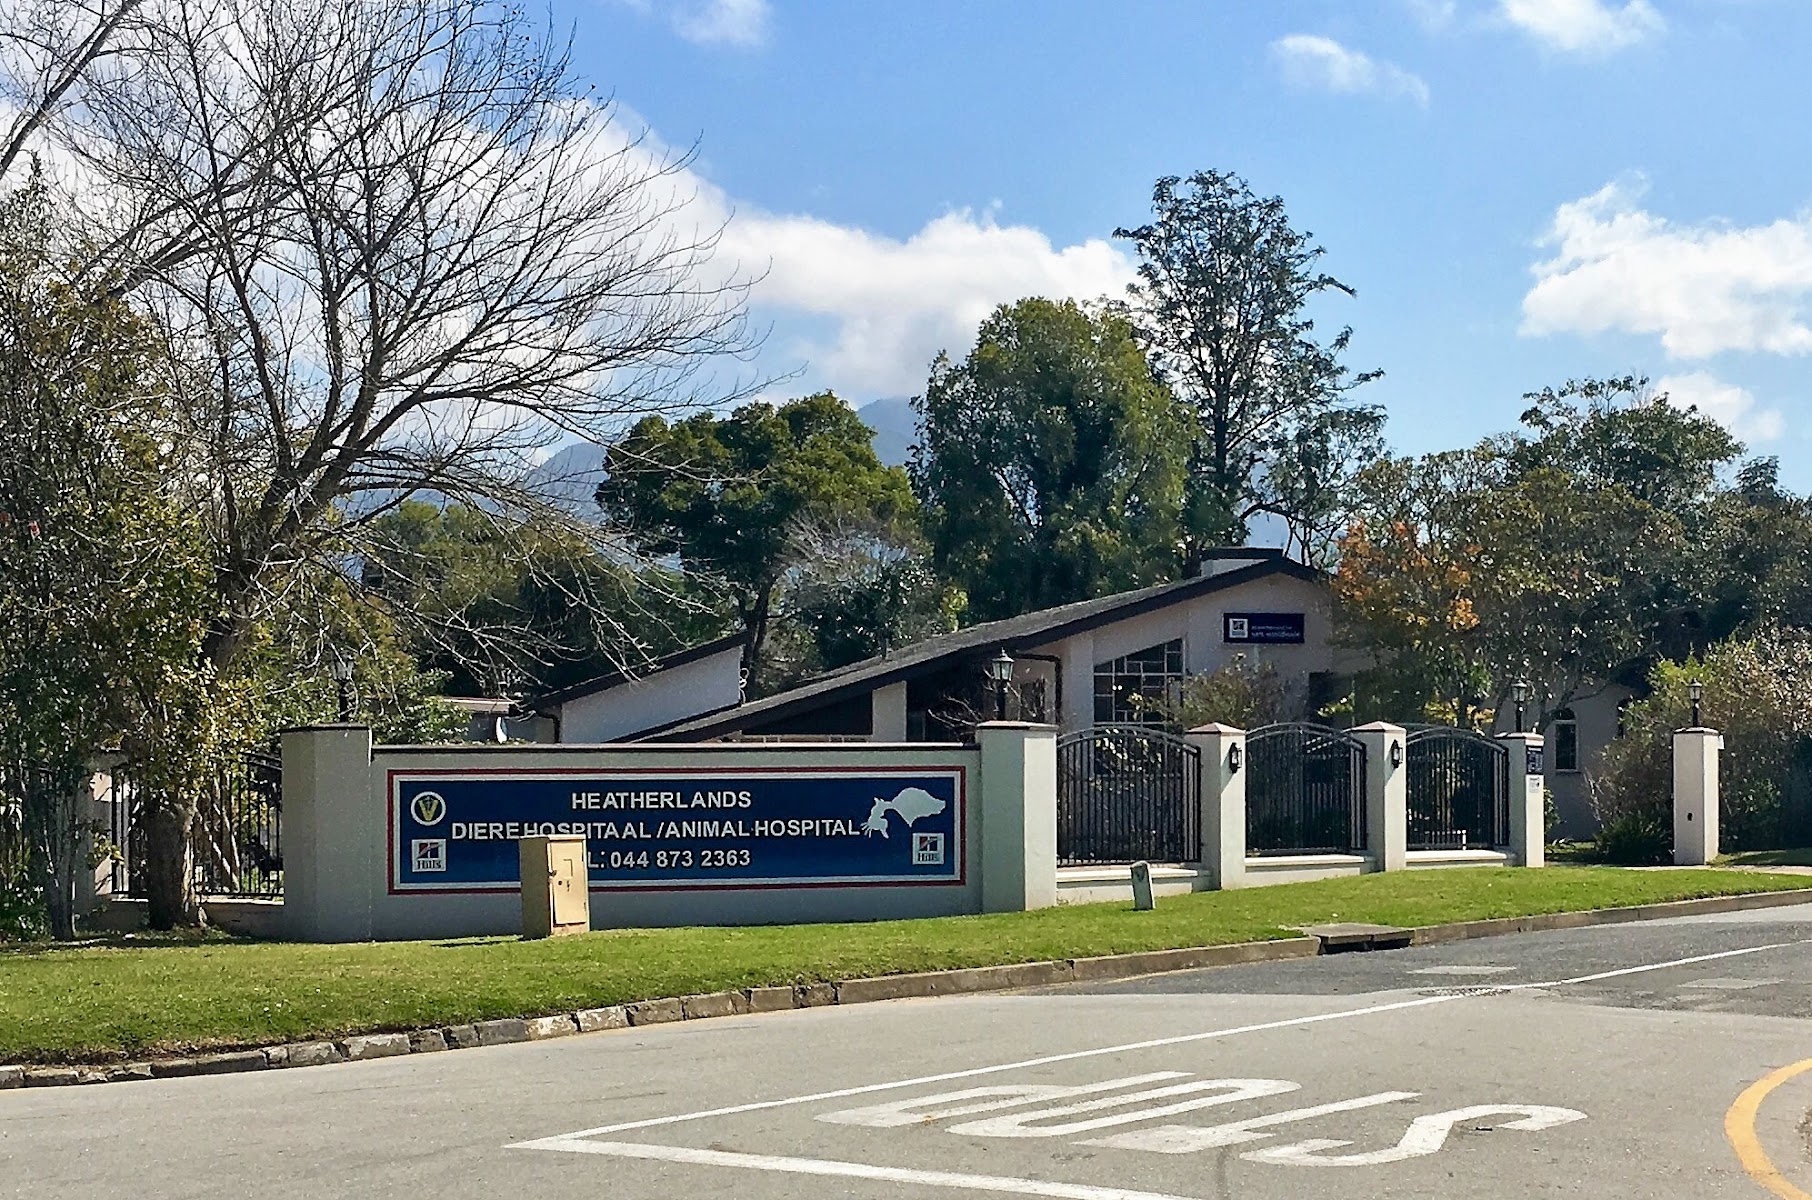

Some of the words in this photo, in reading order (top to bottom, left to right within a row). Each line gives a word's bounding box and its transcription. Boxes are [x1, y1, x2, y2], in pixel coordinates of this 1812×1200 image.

[571, 791, 752, 810] HEATHERLANDS
[754, 819, 861, 837] HOSPITAL
[610, 851, 649, 869] 044
[656, 850, 693, 868] 873
[700, 849, 751, 867] 2363
